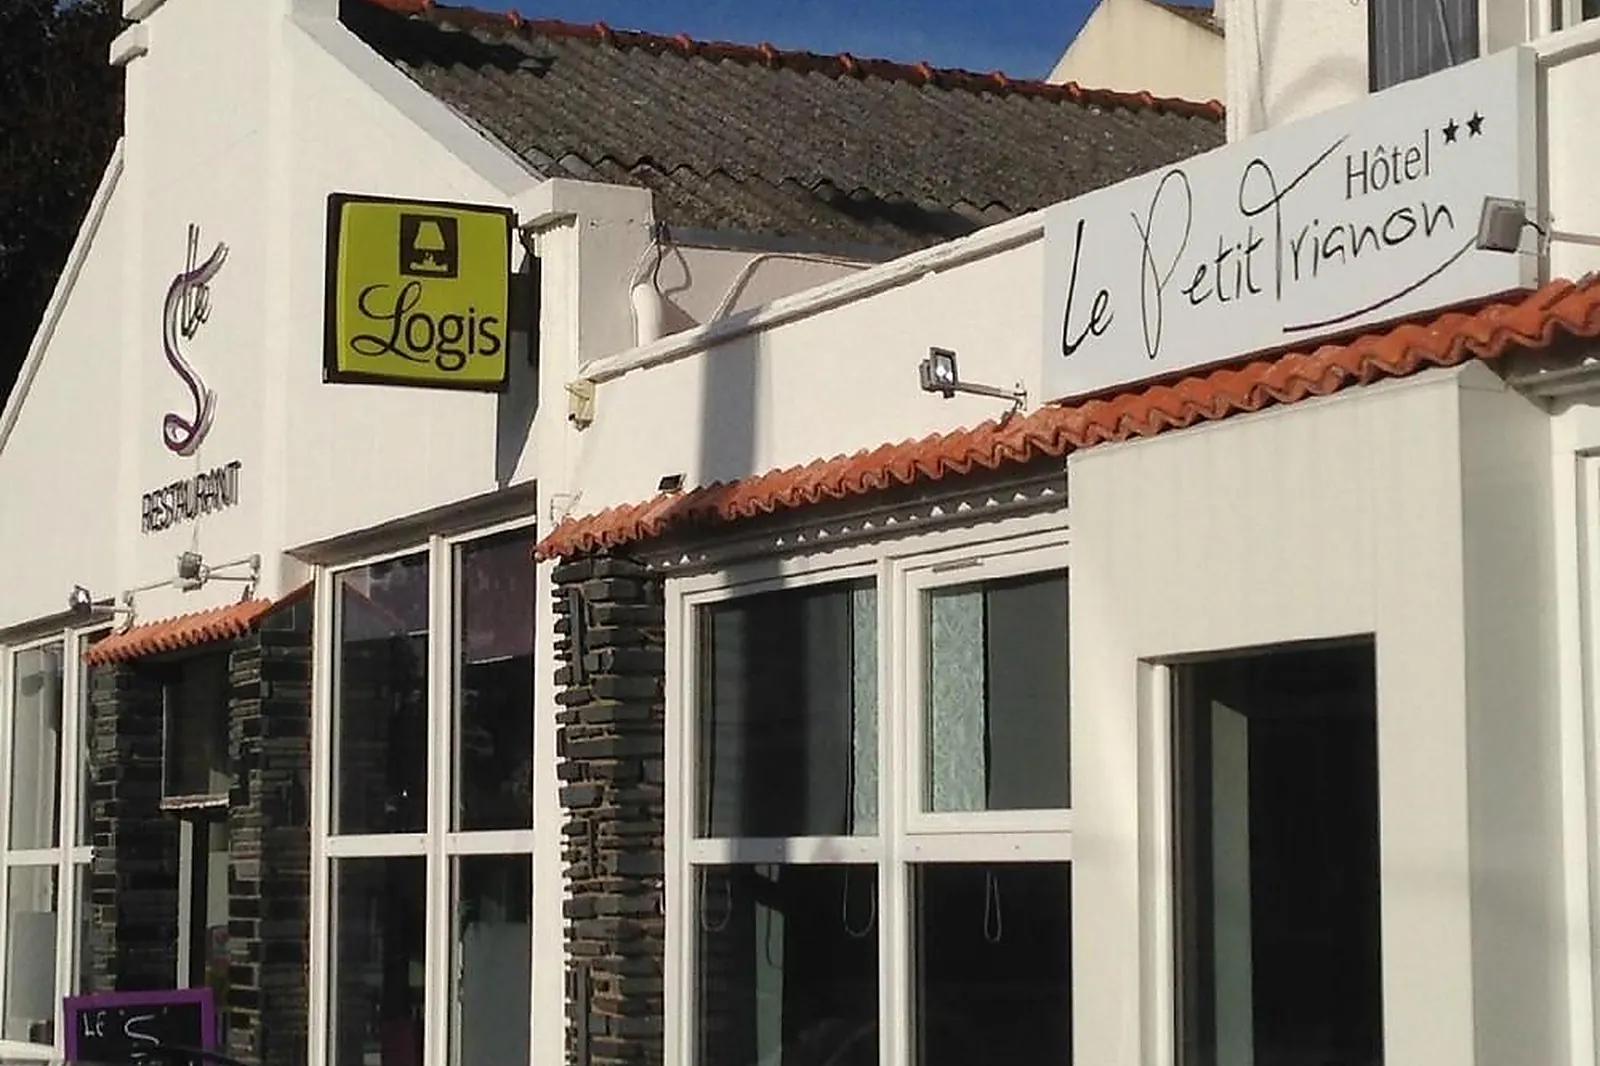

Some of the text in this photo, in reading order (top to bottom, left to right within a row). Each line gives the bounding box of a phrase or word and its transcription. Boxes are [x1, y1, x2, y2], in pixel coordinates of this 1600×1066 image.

[1346, 129, 1430, 200] Hôtel
[1062, 134, 1455, 360] Le Petit Trianon
[350, 280, 501, 371] Logis
[141, 460, 241, 534] RESTAURANT
